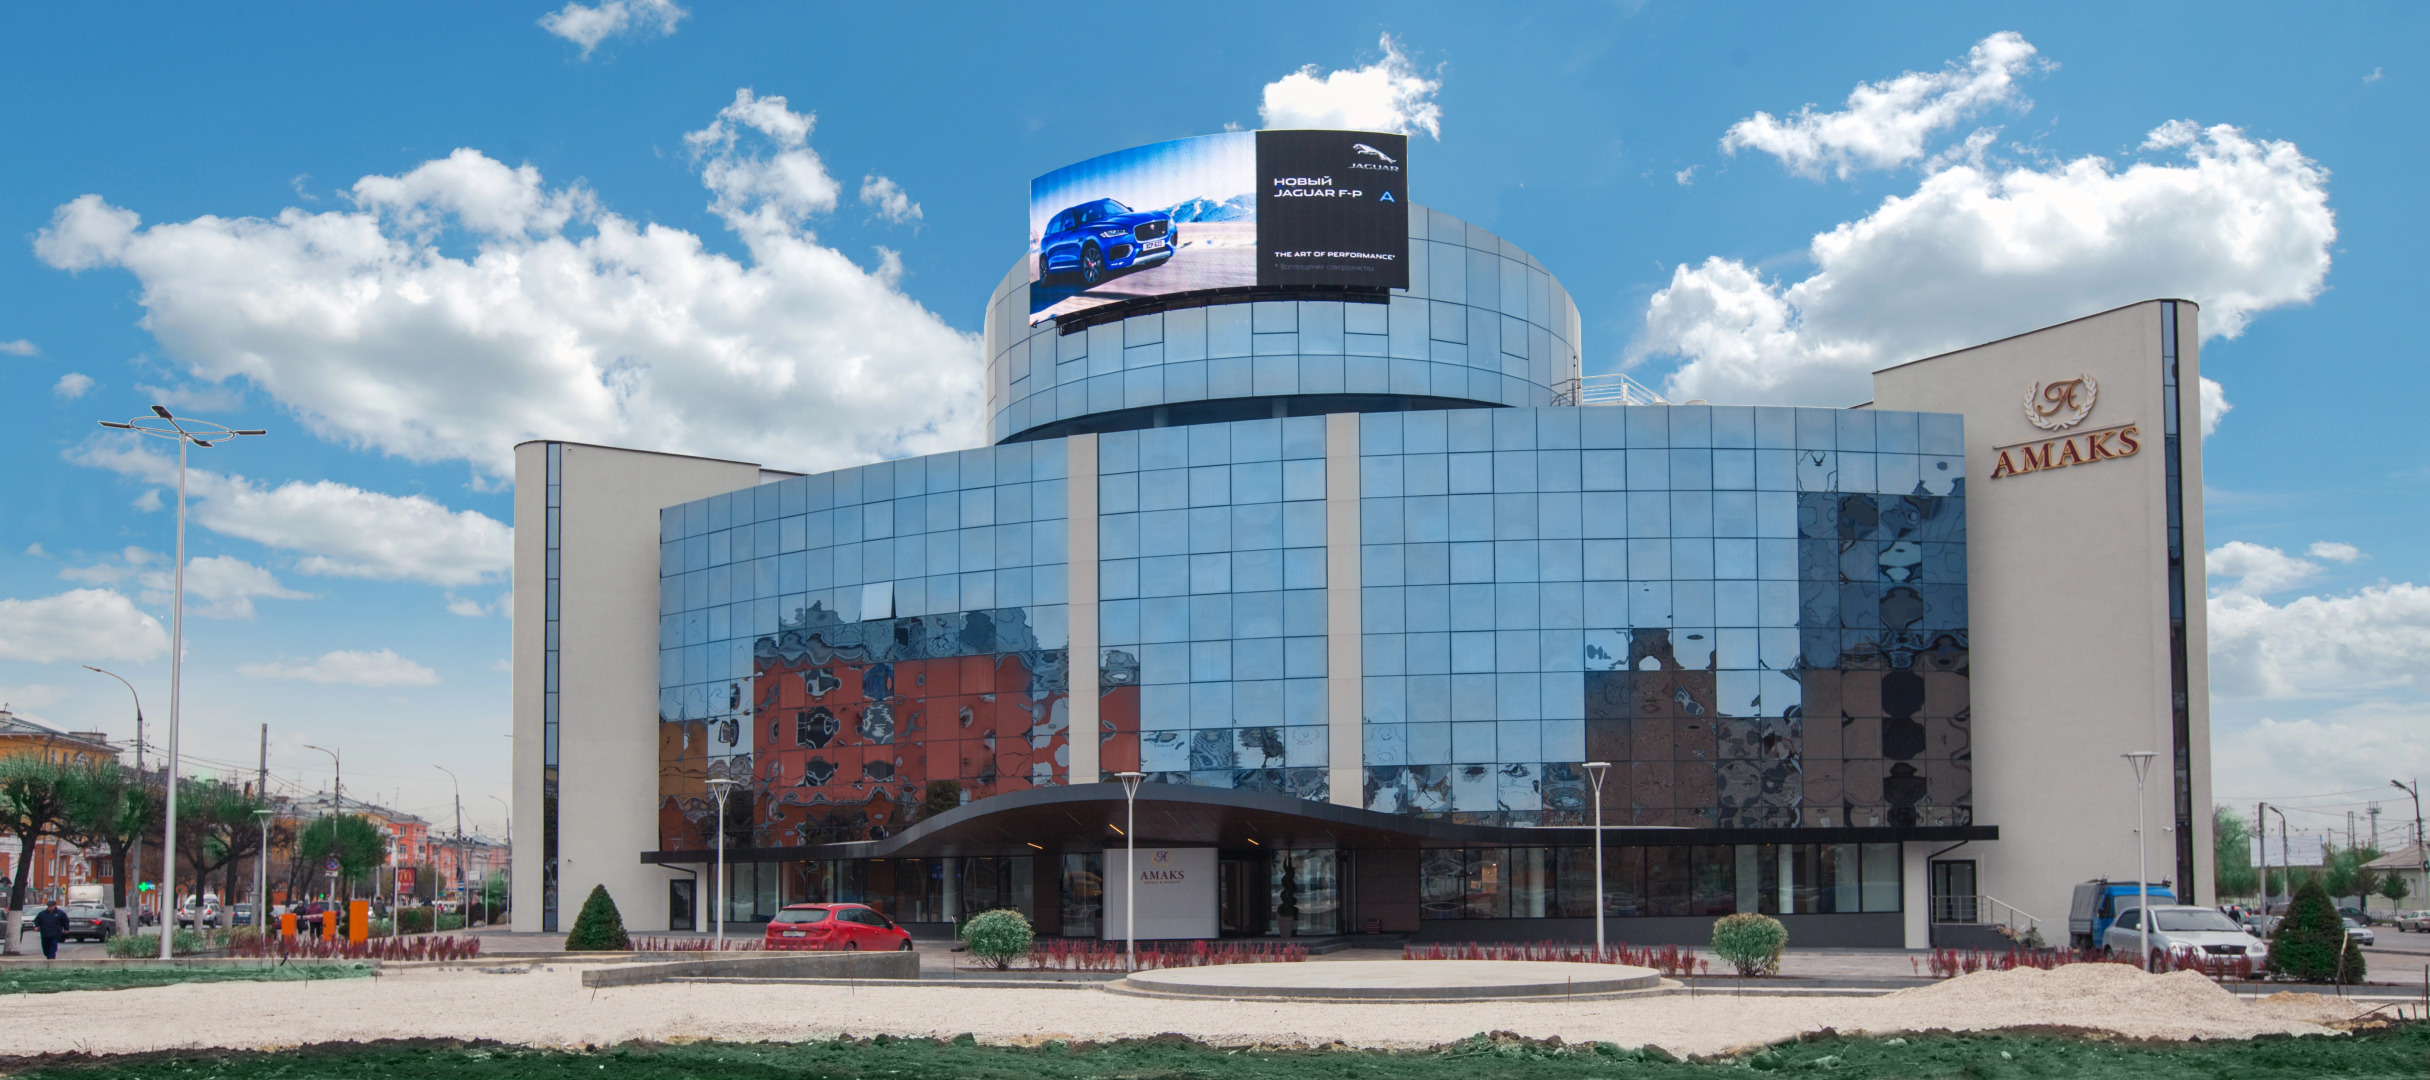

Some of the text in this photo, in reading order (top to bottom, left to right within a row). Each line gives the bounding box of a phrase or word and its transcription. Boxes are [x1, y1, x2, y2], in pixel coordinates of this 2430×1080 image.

[1348, 163, 1399, 172] JAGUAR
[1274, 176, 1332, 186] НОВЫЙ
[1274, 189, 1335, 197] JAGUAR
[1338, 189, 1363, 198] F-P
[1990, 426, 2141, 479] AMAKS
[1140, 870, 1184, 880] AMAKS
